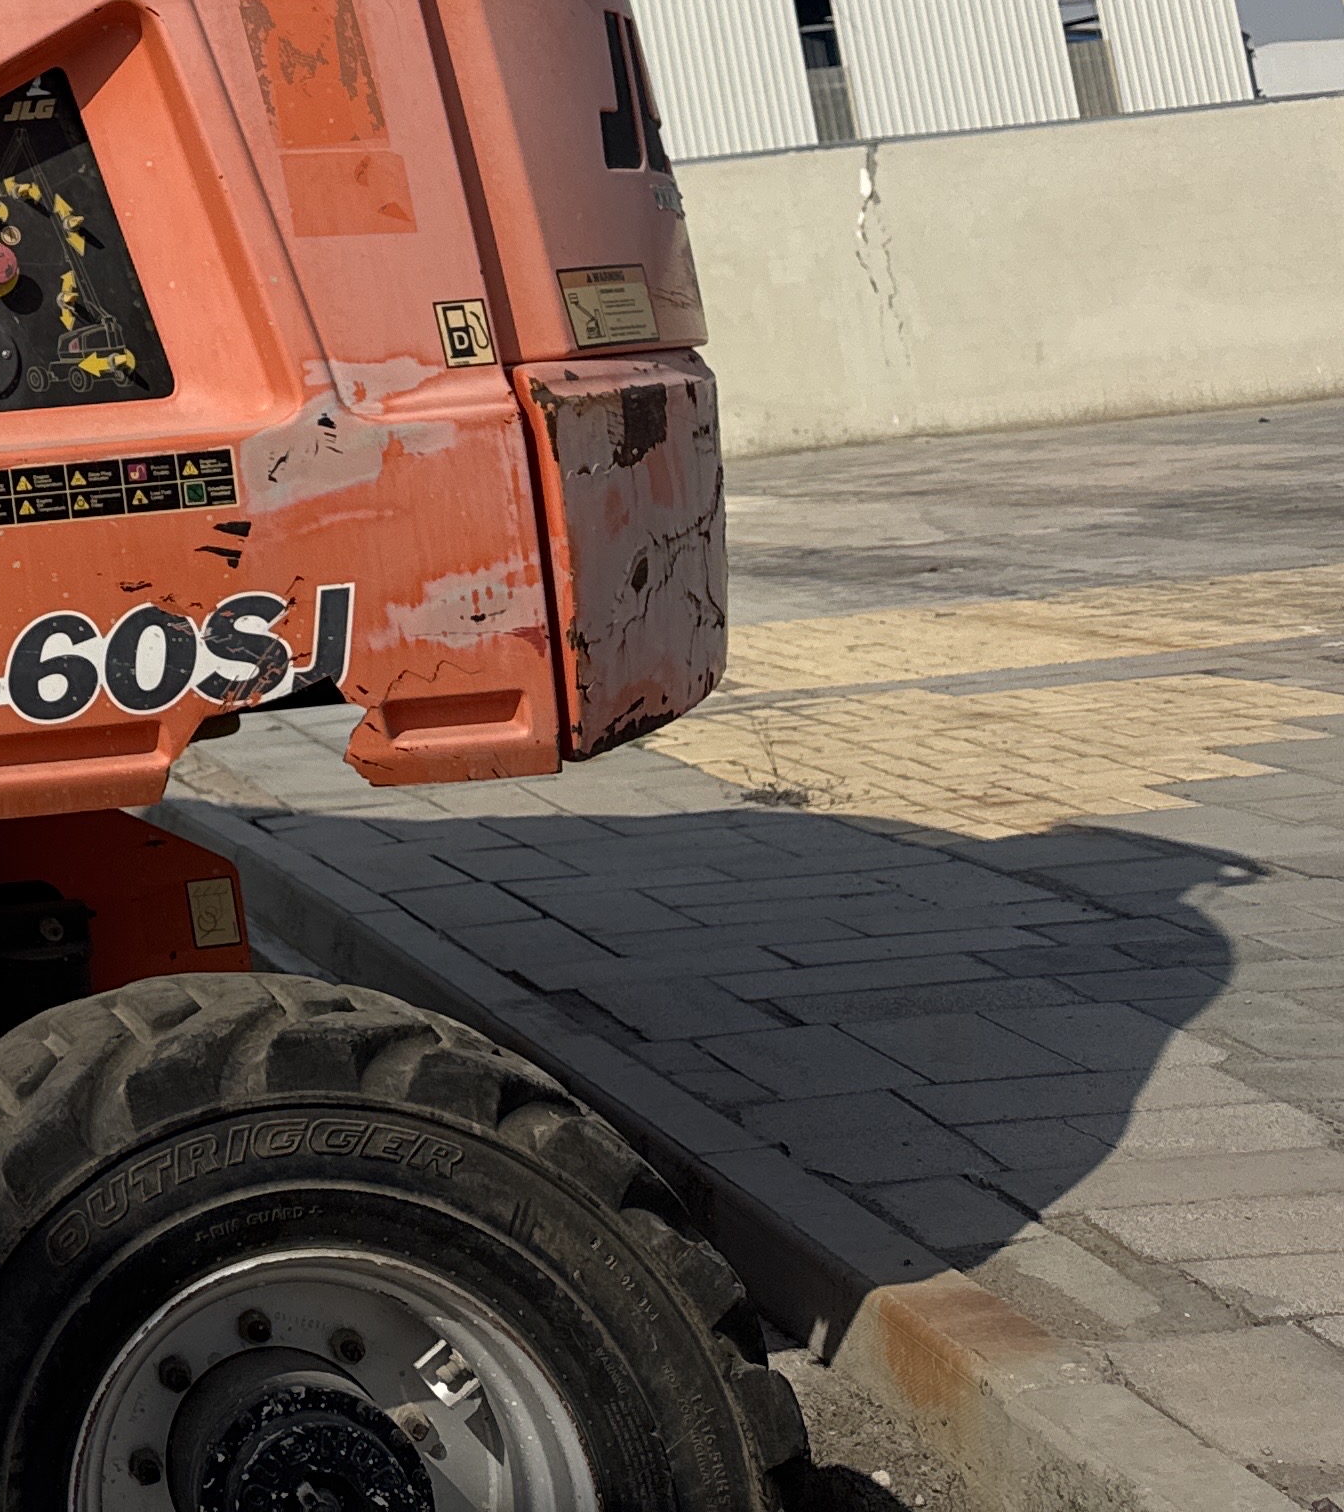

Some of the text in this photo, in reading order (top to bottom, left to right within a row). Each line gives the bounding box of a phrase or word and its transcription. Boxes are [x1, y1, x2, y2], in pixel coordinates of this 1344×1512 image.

[3, 99, 57, 122] JLG
[46, 1118, 464, 1267] OUTRIGGER
[246, 1205, 304, 1226] GUARD
